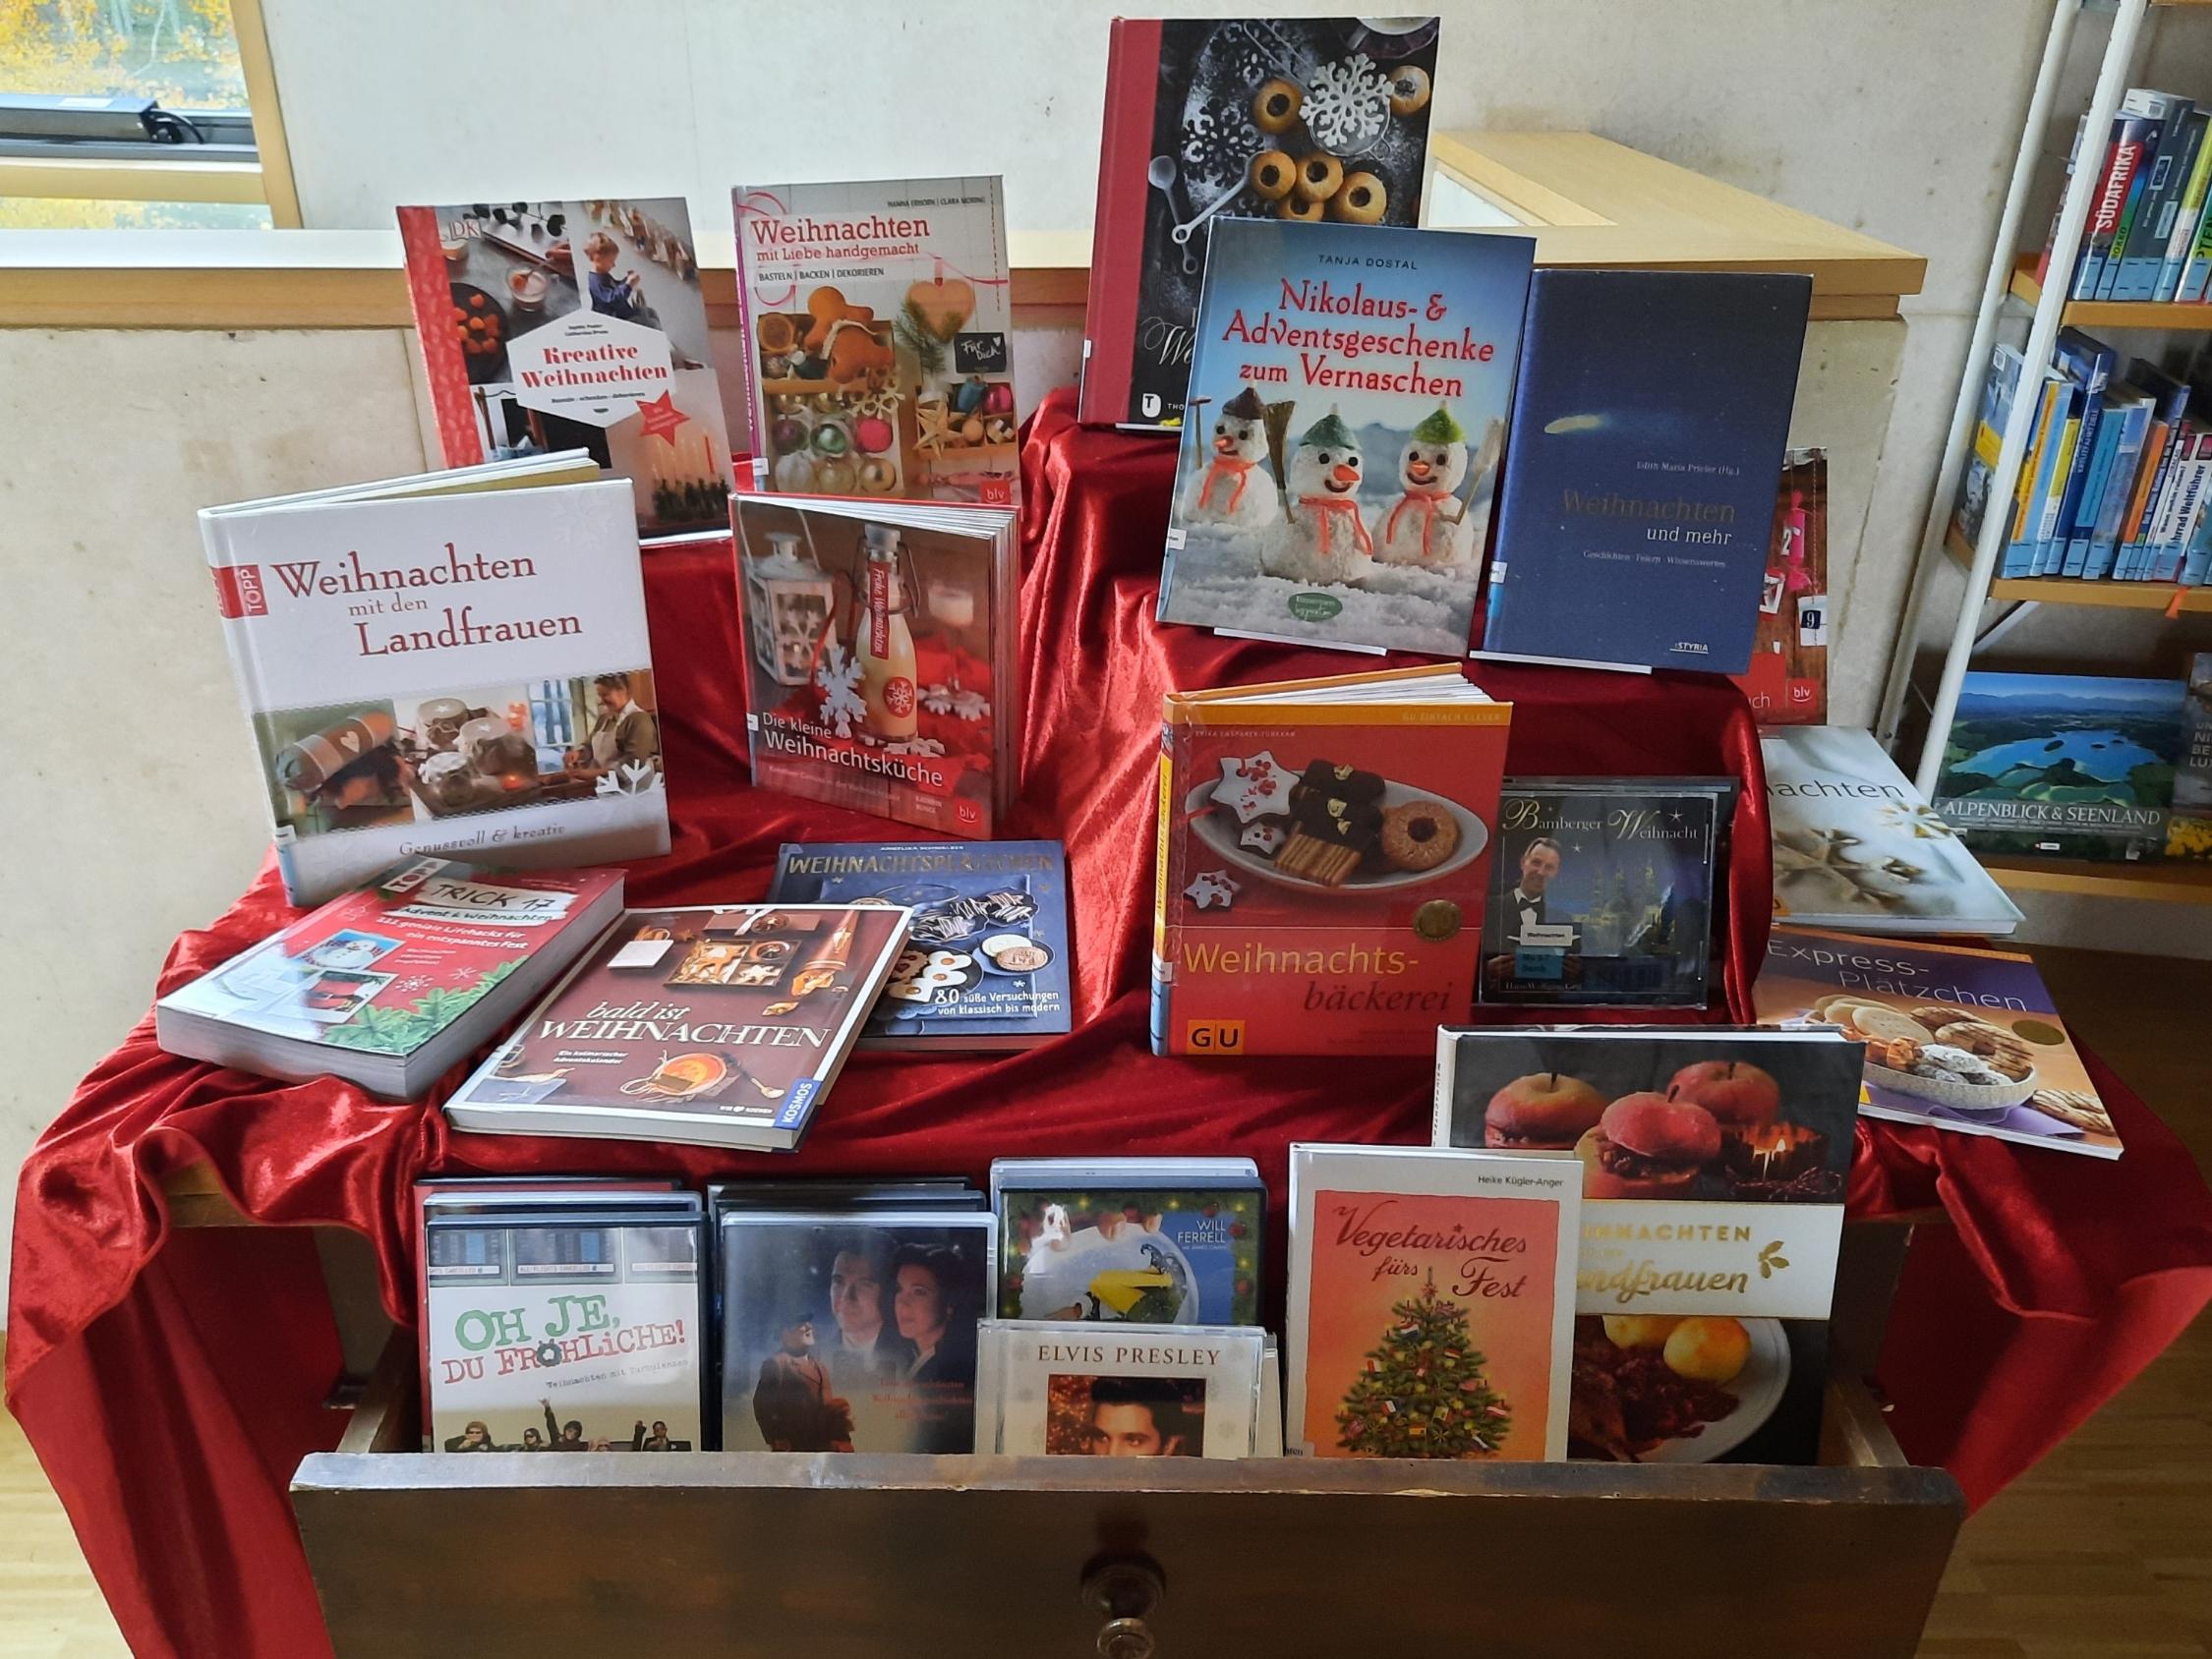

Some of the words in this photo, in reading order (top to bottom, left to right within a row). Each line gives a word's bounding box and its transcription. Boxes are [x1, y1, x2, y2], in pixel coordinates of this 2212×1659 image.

[2095, 144, 2136, 228] SÜDAFRIKA
[452, 222, 480, 237] DK
[750, 215, 930, 245] Weihnachten
[757, 250, 778, 261] mit
[783, 246, 822, 260] Liebe
[826, 244, 919, 259] handgemacht
[1318, 254, 1360, 265] TANJA
[1366, 257, 1418, 269] DOSTAL
[759, 271, 792, 282] BASTELN
[799, 270, 830, 280] BACKEN
[837, 268, 885, 278] DEKORIEREN
[1279, 277, 1418, 318] Nikolaus-
[1426, 292, 1447, 321] &
[1222, 309, 1494, 362] Adventsgeschenke
[543, 344, 638, 365] Kreative
[521, 366, 668, 388] Weihnachten
[1240, 364, 1287, 382] zum
[1300, 353, 1463, 397] Vernaschen
[1563, 488, 1736, 523] Weihnachten
[1647, 526, 1679, 541] und
[1685, 529, 1732, 544] mehr
[270, 543, 537, 600] Weihnachten
[241, 568, 263, 613] TOPP
[348, 598, 383, 615] mit
[391, 593, 428, 612] den
[354, 606, 583, 657] Landfrauen
[1807, 611, 1816, 628] 9
[1794, 687, 1810, 698] blv
[763, 713, 785, 729] Die
[790, 716, 832, 739] kleine
[764, 729, 944, 787] Weihnachtsküche
[959, 806, 975, 819] blv
[1502, 798, 1602, 831] Bamberger
[1607, 809, 1698, 840] Weihnacht
[1944, 801, 2048, 820] ALPENBLICK
[2052, 807, 2063, 820] &
[2066, 807, 2160, 825] SEENLAND
[399, 830, 486, 856] Genussvoll
[492, 829, 507, 841] &
[512, 822, 566, 841] kreativ
[431, 884, 516, 908] TRICK
[522, 898, 554, 912] 17
[401, 907, 446, 918] Advent
[467, 912, 553, 922] Weihnachten
[399, 920, 441, 932] geniale
[443, 925, 502, 938] Lifehacks
[427, 935, 499, 948] entspanntes
[1184, 943, 1420, 975] Weihnachts-
[1768, 941, 1930, 976] Express-
[935, 989, 960, 1004] 80
[989, 991, 1059, 1002] Versuchungen
[938, 1005, 956, 1015] von
[959, 1003, 1002, 1014] klassisch
[1005, 1003, 1019, 1014] bis
[1021, 1002, 1060, 1013] modern
[1304, 980, 1453, 1012] bäckerei
[587, 1001, 656, 1020] bald
[654, 1003, 691, 1020] ist
[536, 1019, 833, 1049] WEIHNACHTEN
[1192, 1028, 1239, 1048] GU
[782, 1082, 813, 1123] KOSMOS
[1478, 1175, 1502, 1185] Heike
[1505, 1175, 1563, 1187] Kügler-Anger
[1178, 1231, 1226, 1243] FERRELL
[1196, 1220, 1226, 1230] WILL
[1332, 1200, 1527, 1256] Vegetarisches
[1371, 1256, 1419, 1282] fürs
[1452, 1256, 1527, 1298] Fest
[455, 1307, 532, 1351] OH
[545, 1294, 620, 1337] JE,
[1038, 1344, 1104, 1362] ELVIS
[1116, 1347, 1221, 1366] PRESLEY
[441, 1356, 484, 1384] DU
